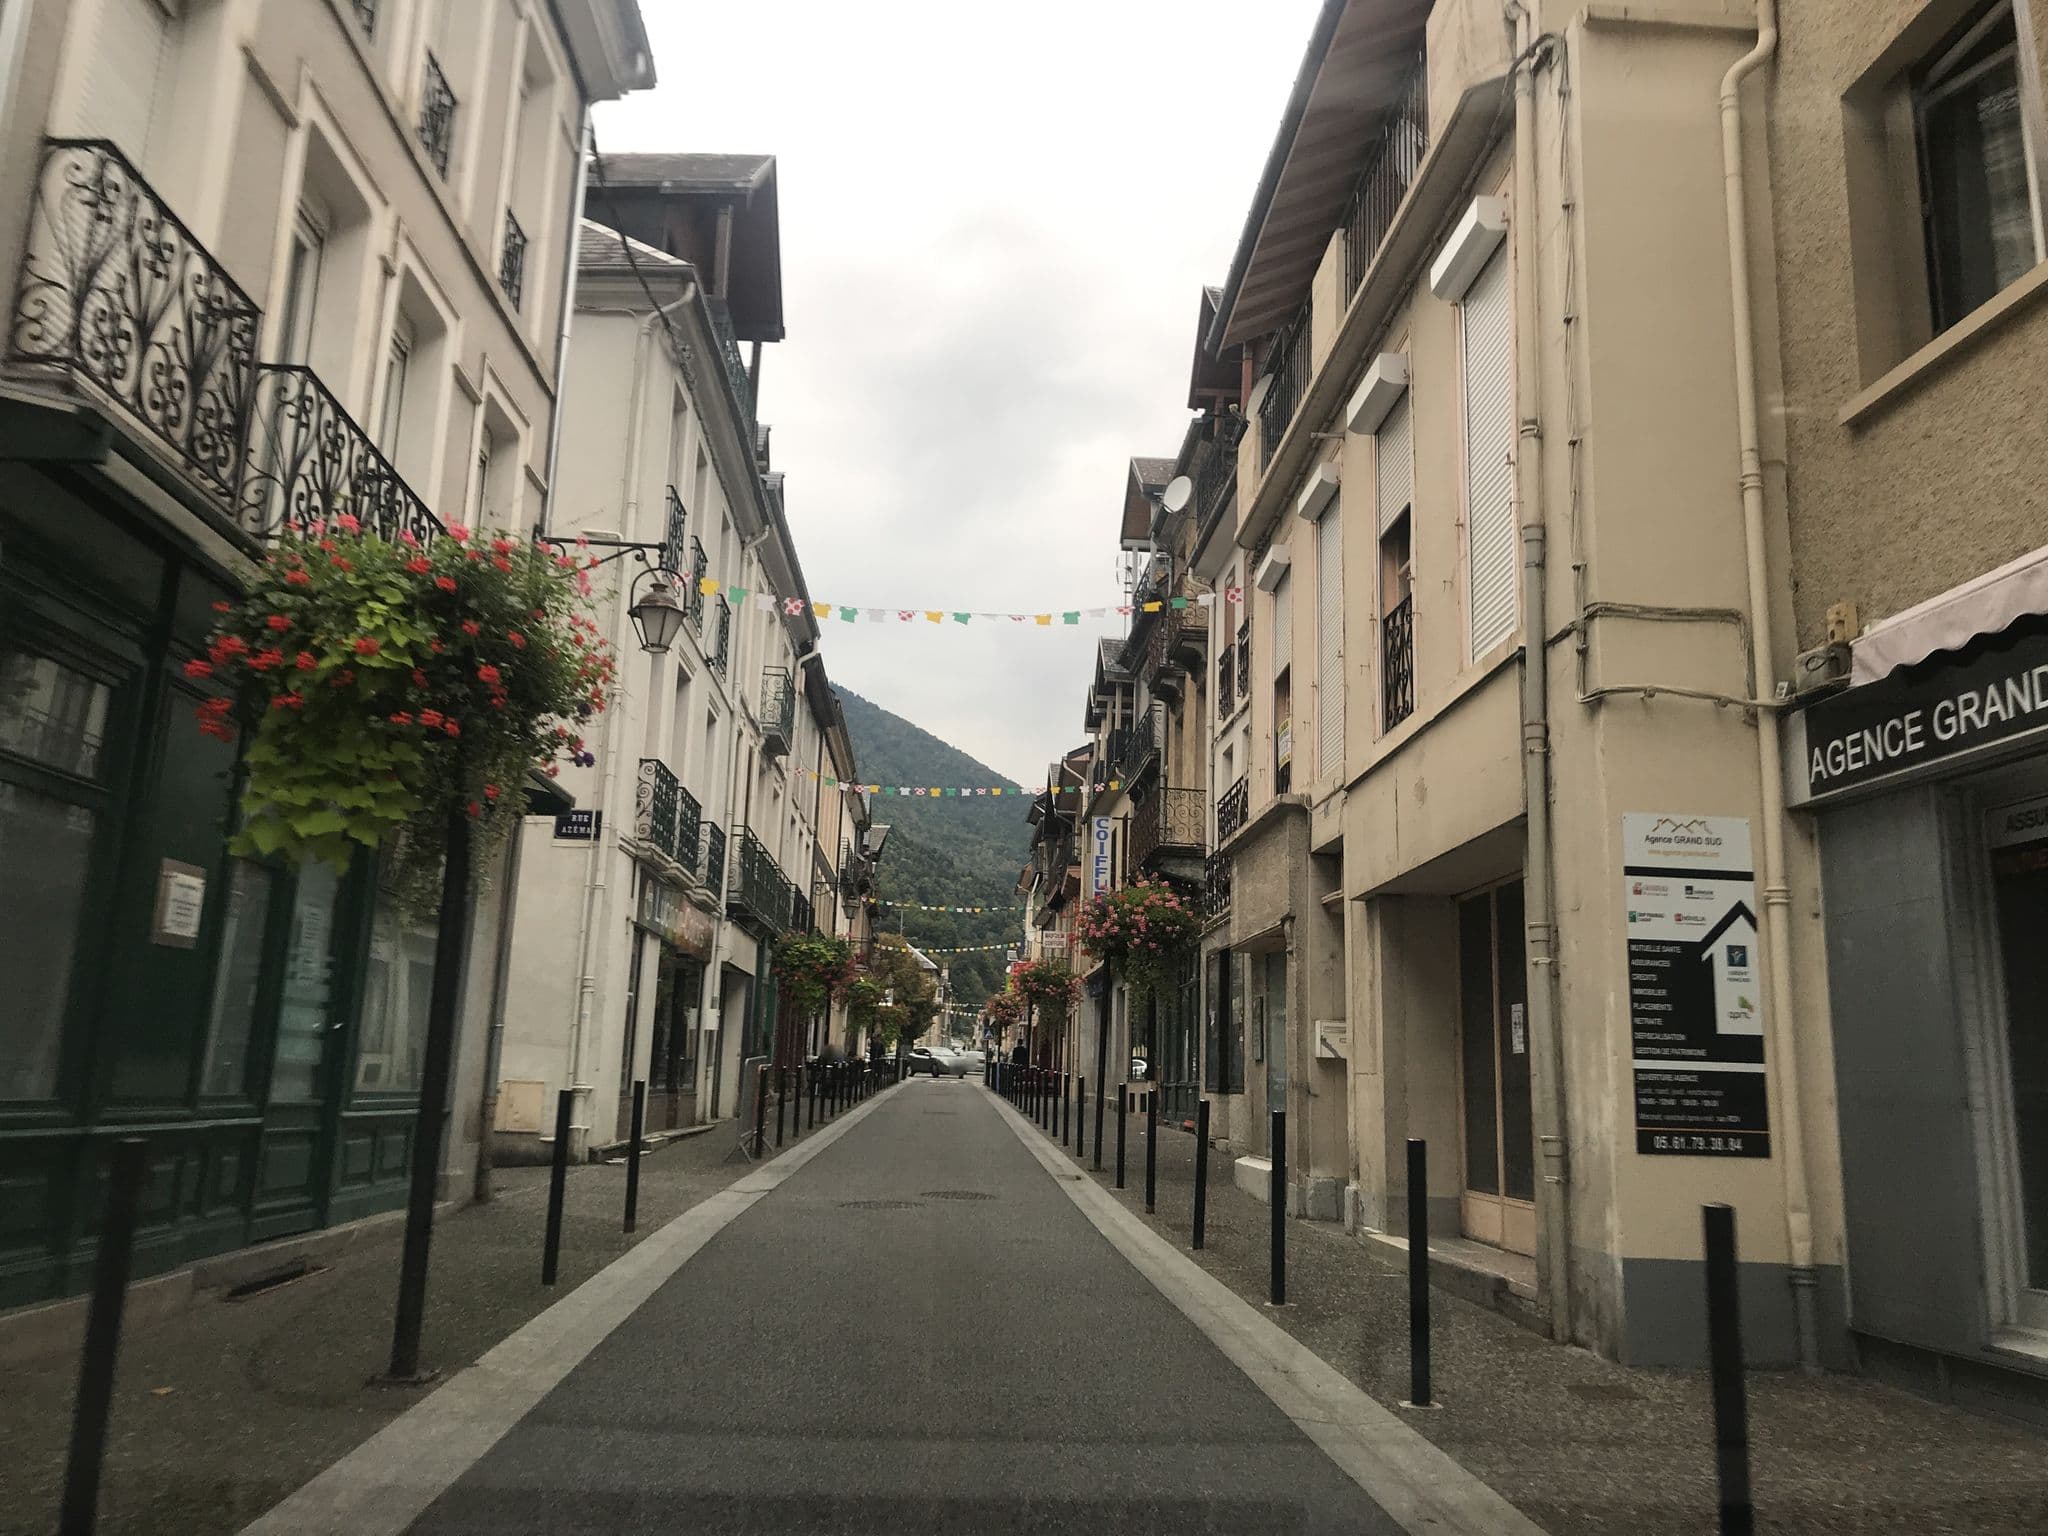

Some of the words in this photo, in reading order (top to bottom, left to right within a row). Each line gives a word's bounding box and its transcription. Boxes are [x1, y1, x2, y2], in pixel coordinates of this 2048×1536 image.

[1810, 711, 1926, 784] AGENCE
[1932, 665, 2048, 741] GRAND
[571, 814, 590, 822] RUE
[1645, 834, 1673, 845] Agence
[1673, 835, 1703, 845] GRAND
[1704, 837, 1722, 846] SUD
[1094, 818, 1109, 897] COIFFU
